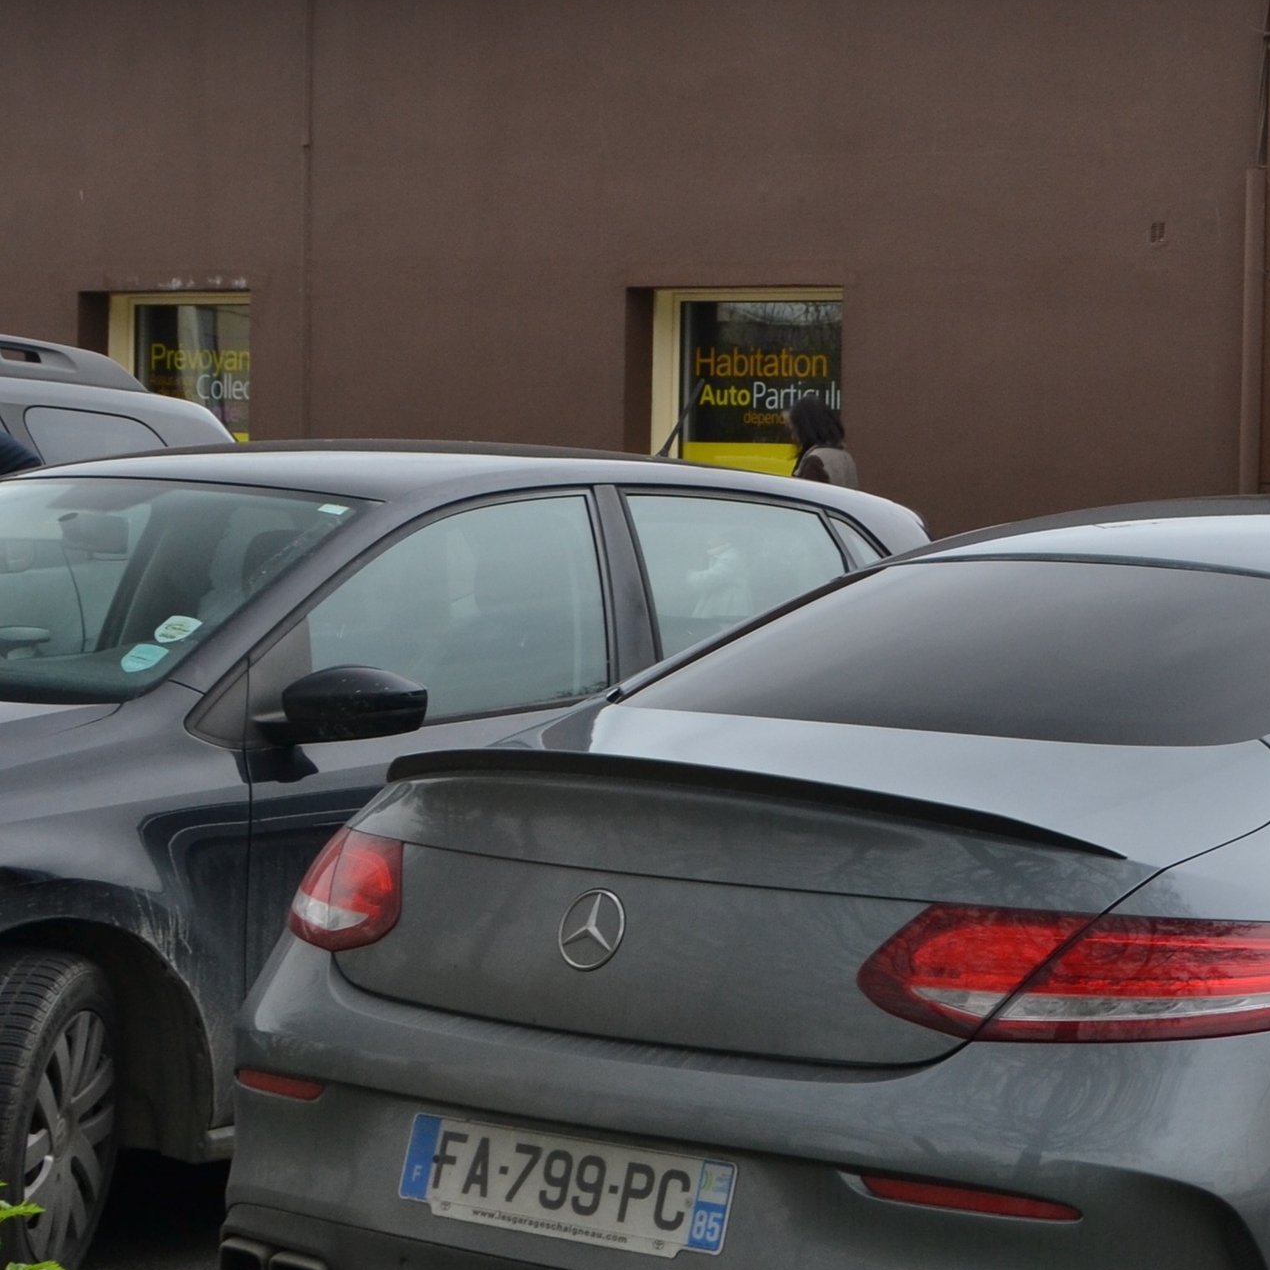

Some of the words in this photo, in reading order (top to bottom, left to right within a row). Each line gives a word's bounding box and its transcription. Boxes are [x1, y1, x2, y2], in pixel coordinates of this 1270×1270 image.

[695, 347, 828, 377] Habitation
[700, 384, 750, 405] Auto
[411, 1165, 422, 1180] F
[431, 1131, 691, 1231] FA-799-PC
[472, 1208, 628, 1244] www.lesgarageschaigneau.com
[692, 1210, 723, 1242] 85
